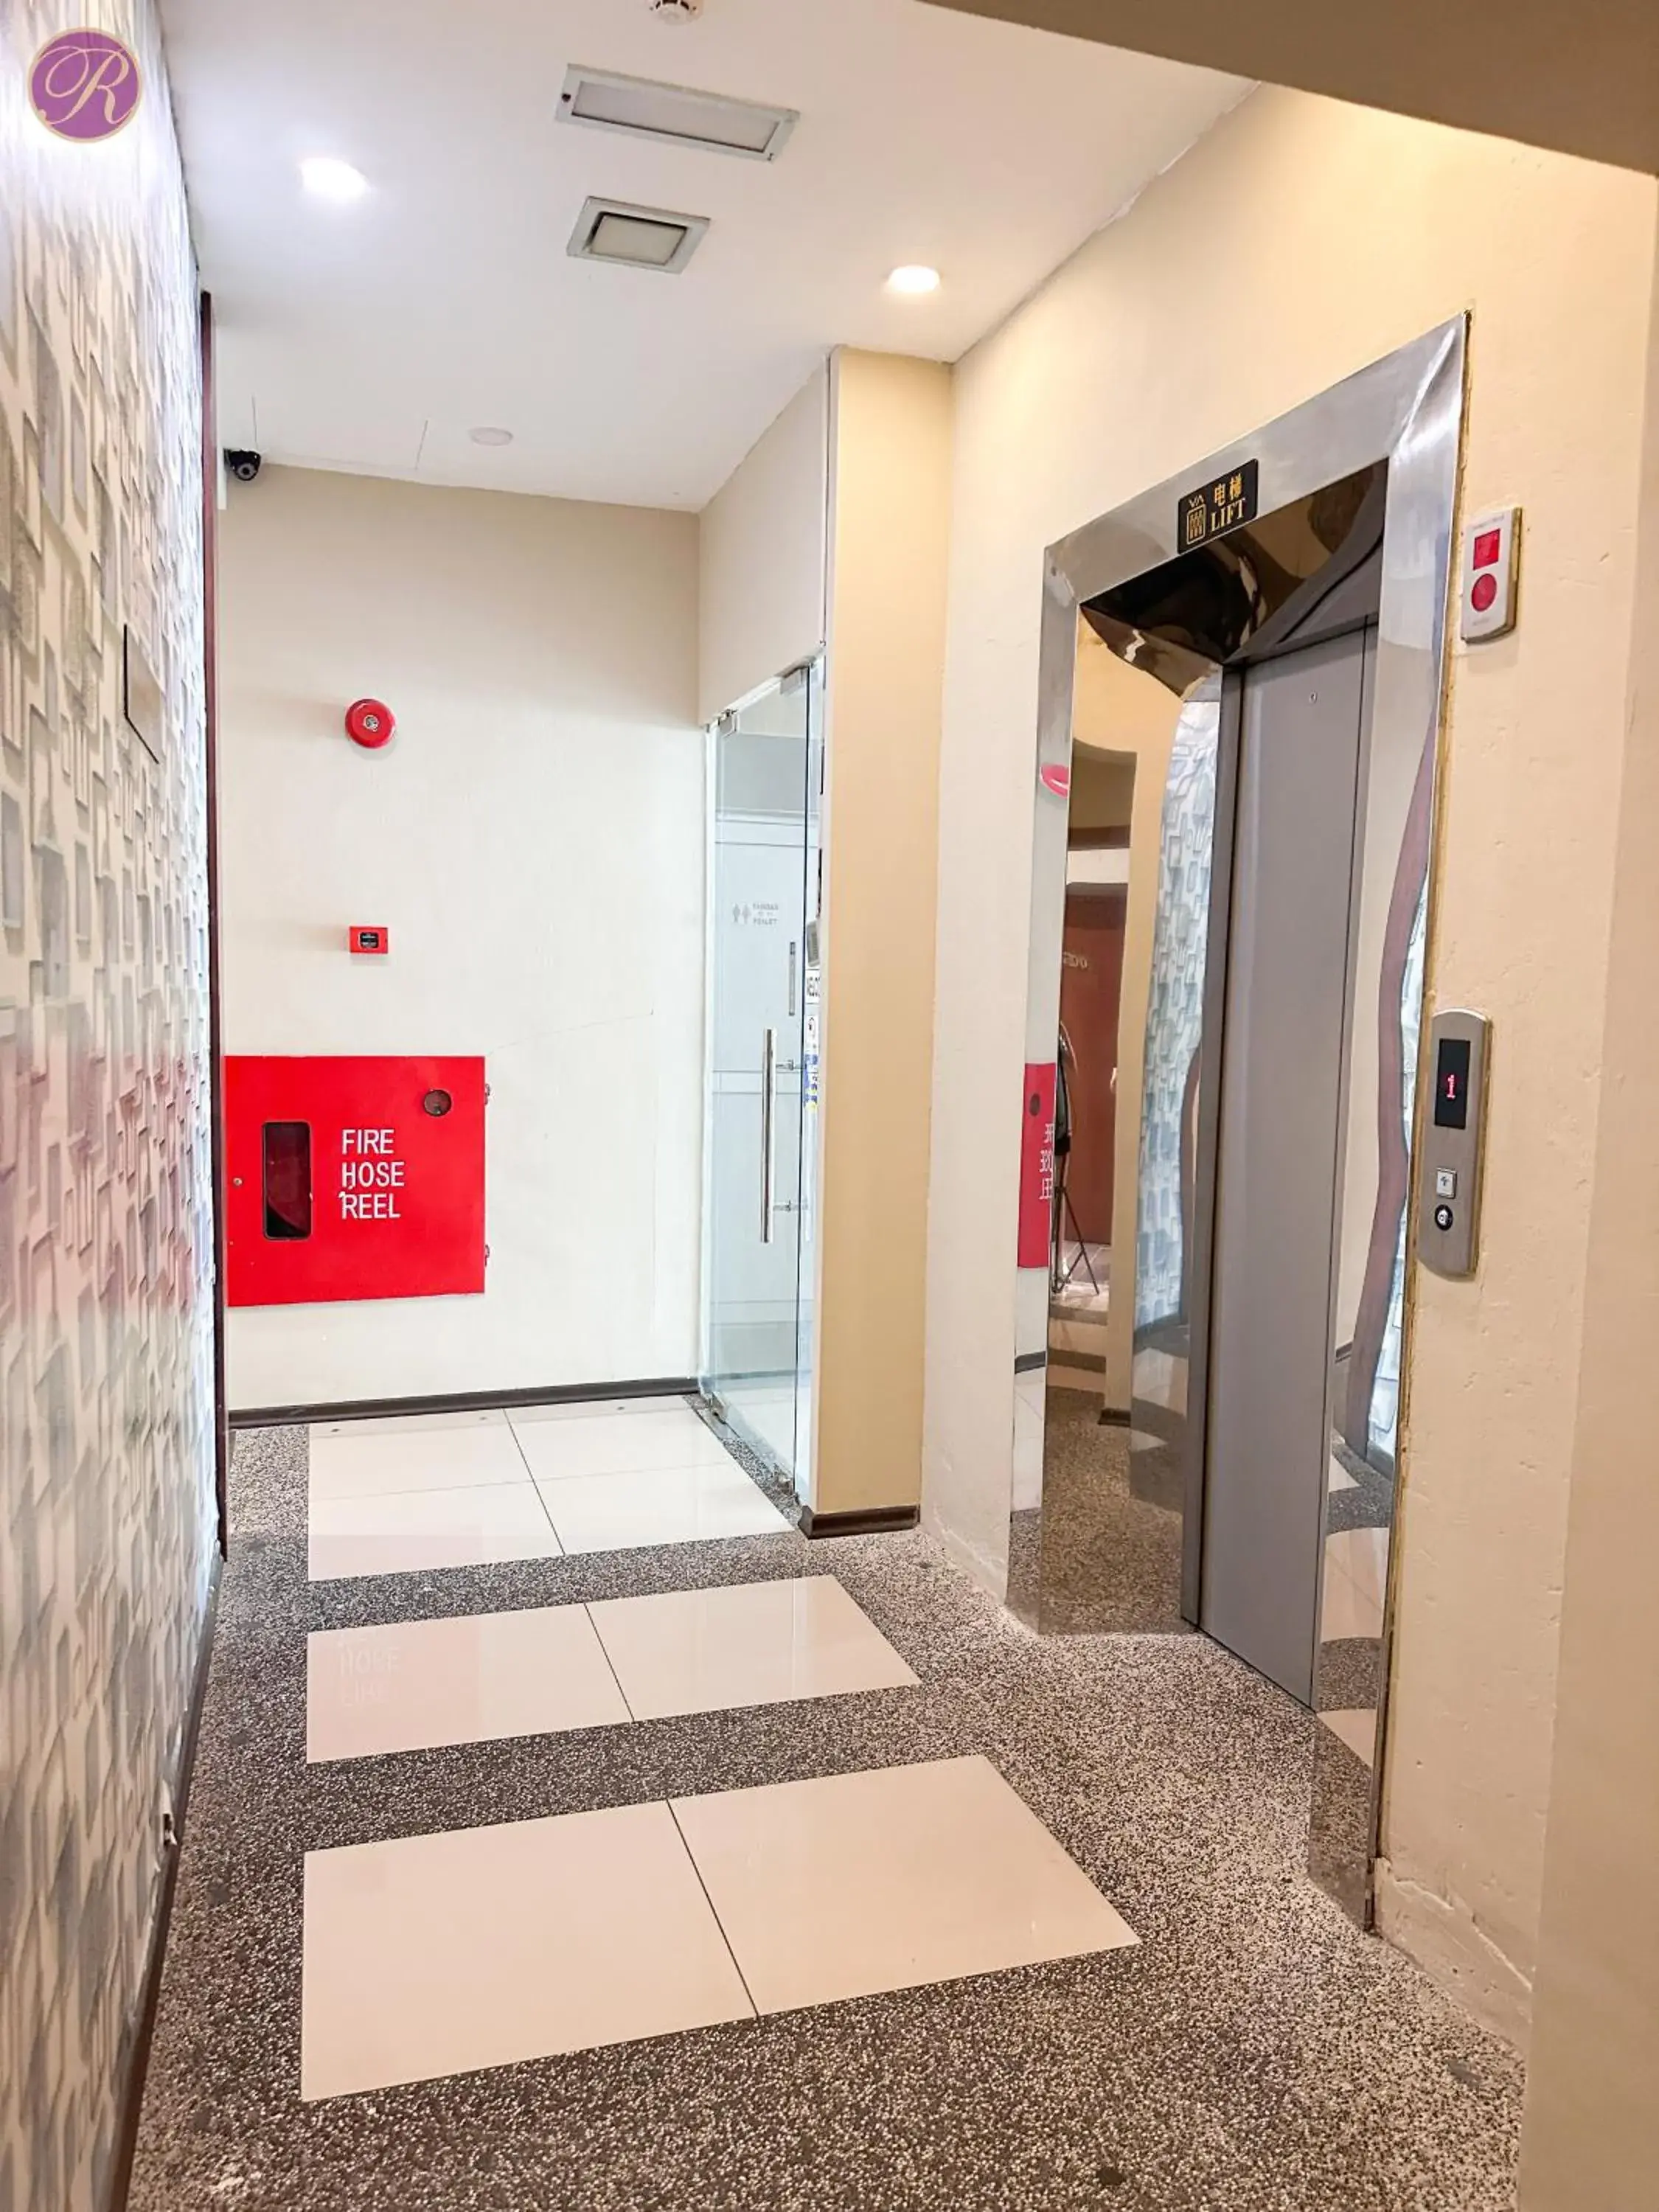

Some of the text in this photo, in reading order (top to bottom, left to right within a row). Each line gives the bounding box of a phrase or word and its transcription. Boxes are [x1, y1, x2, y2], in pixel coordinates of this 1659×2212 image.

[1211, 498, 1245, 531] LIFT
[1447, 1074, 1456, 1099] 1
[341, 1129, 394, 1155] FIRE
[341, 1161, 405, 1188] HOSE
[341, 1192, 401, 1220] REEL
